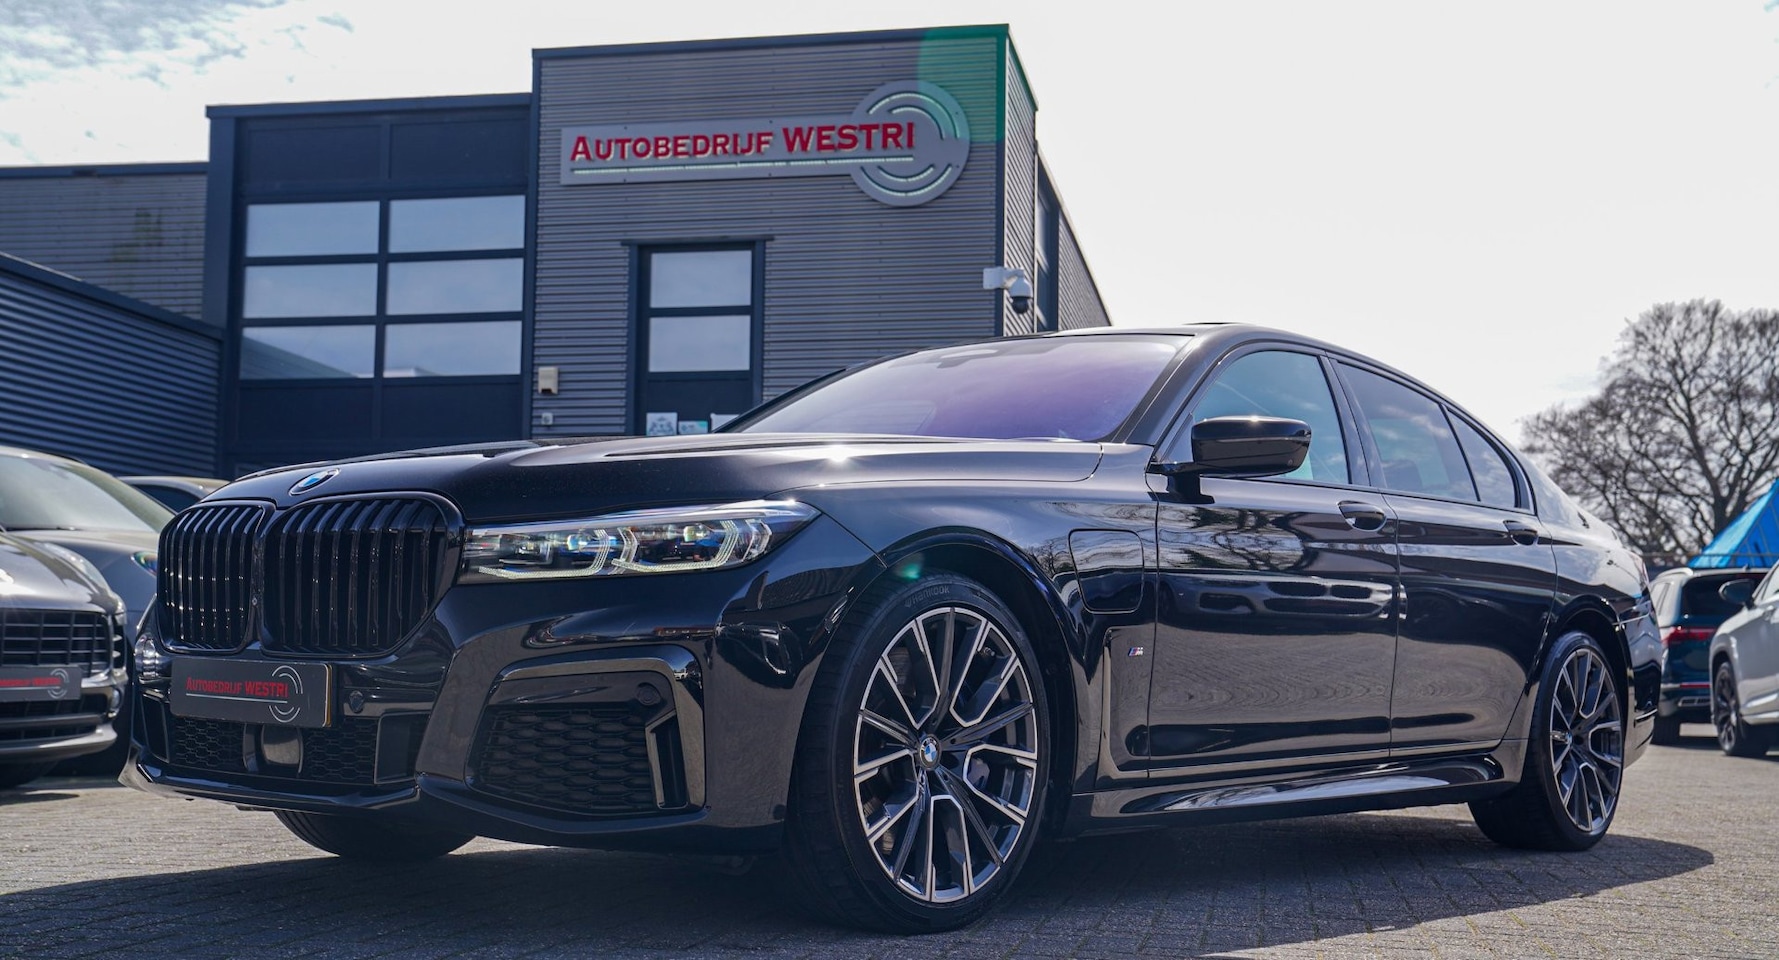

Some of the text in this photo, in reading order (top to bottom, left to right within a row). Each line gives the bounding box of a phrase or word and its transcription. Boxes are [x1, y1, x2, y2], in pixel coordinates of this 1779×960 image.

[570, 121, 914, 161] AUTOBEDRIJF WESTRI
[186, 676, 288, 698] AUTOBEDRIJF WESTRI
